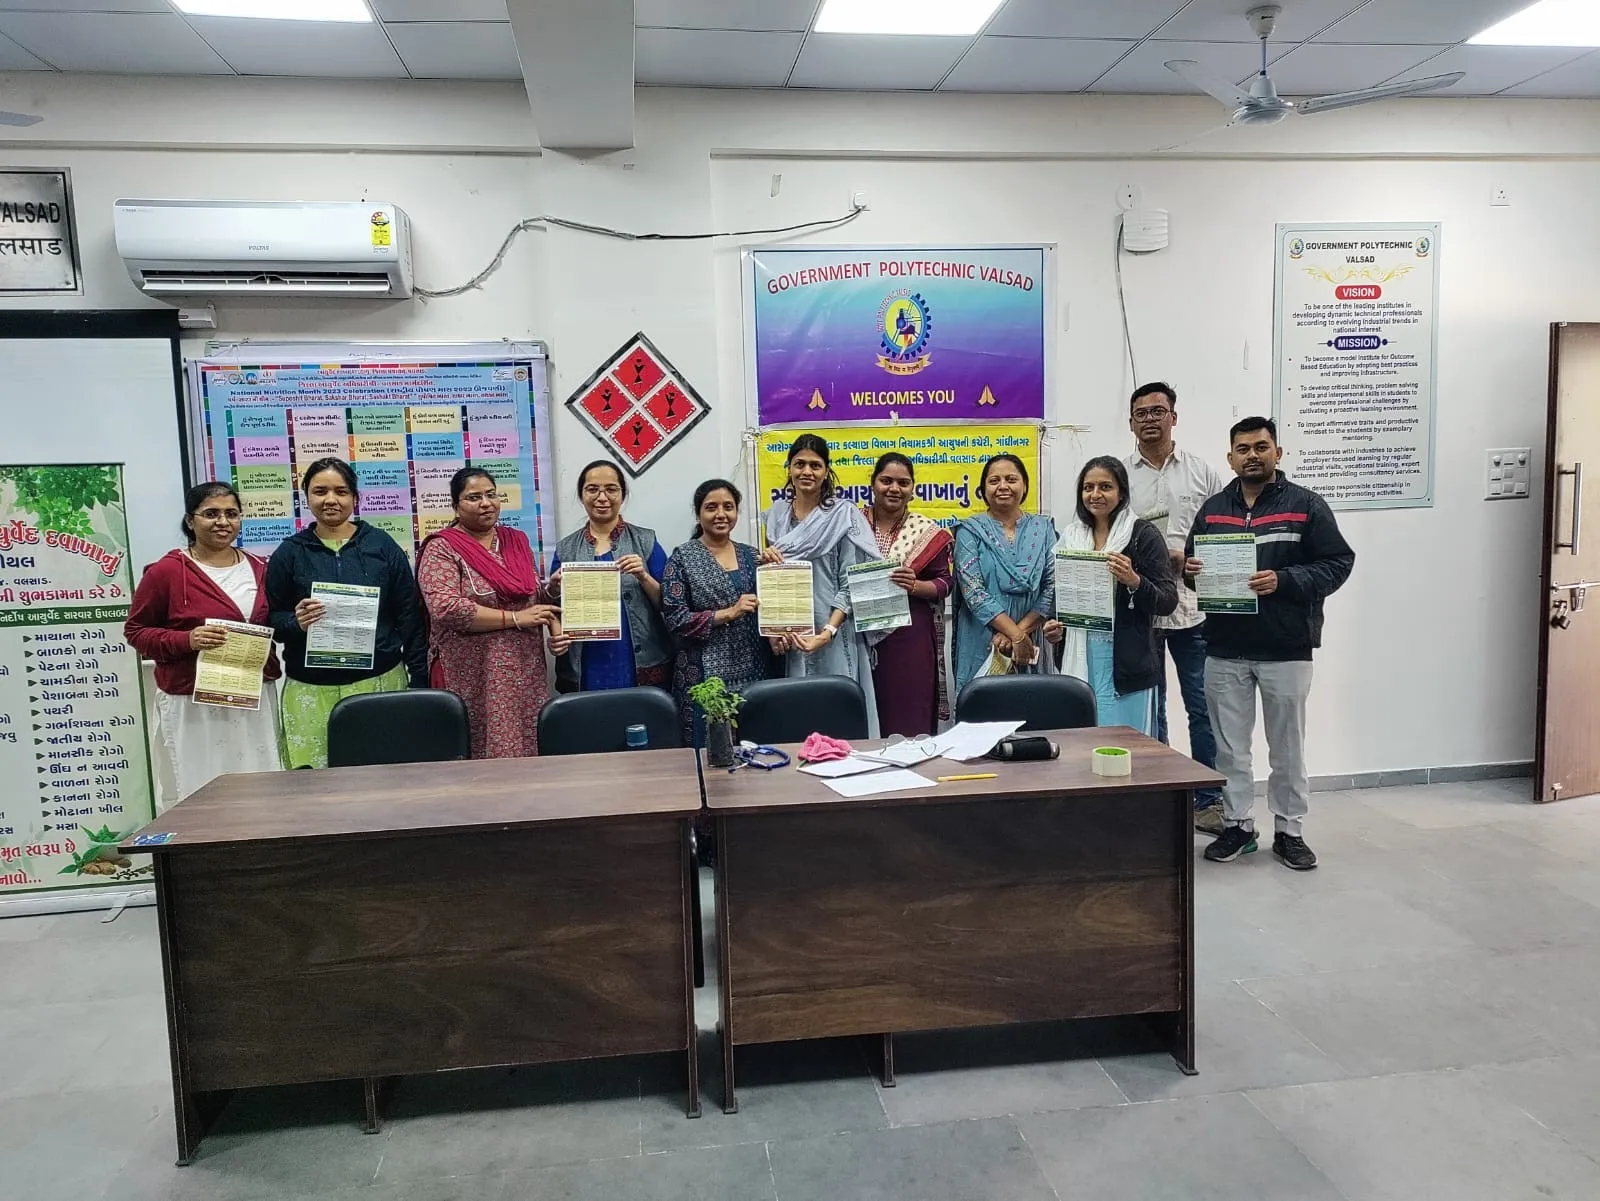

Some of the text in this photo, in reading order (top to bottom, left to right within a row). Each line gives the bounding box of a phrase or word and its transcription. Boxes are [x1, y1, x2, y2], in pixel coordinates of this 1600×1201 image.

[0, 238, 63, 255] लसाड
[1306, 241, 1413, 250] GOVERNMENT POLYTECHNIC
[768, 261, 1033, 295] GOVERNMENT POLYTECHNIC VALSAD
[1342, 288, 1375, 297] VISION
[1293, 311, 1325, 319] developing
[1328, 311, 1352, 319] dynamic
[1383, 309, 1422, 318] professionals
[1338, 339, 1377, 348] MISSION
[1356, 362, 1379, 370] adopting
[1309, 384, 1330, 392] develop
[851, 389, 955, 407] WELCOMES YOU
[1338, 398, 1370, 406] professional
[1388, 418, 1419, 426] productive
[844, 439, 868, 450] કલ્યાણ
[871, 437, 896, 448] વિભાગ
[996, 436, 1029, 447] ગાંધીનગર
[835, 458, 850, 466] તથા
[853, 455, 874, 465] જિલ્લા
[950, 455, 976, 463] વલસાડ
[1357, 455, 1381, 463] learning
[1383, 454, 1389, 462] by
[1359, 469, 1394, 477] consultancy
[911, 475, 971, 508] વાખાનું
[0, 520, 124, 577] યુર્વેદ દવાખાનું
[19, 589, 84, 606] શુભકામના
[89, 585, 105, 598] કરે
[28, 610, 60, 623] આયુર્વેદ
[64, 611, 92, 620] સારવાર
[35, 629, 105, 642] માથાના રોગો
[37, 643, 126, 656] બાળકો ના રોગો
[38, 659, 98, 671] પેટના રોગો
[40, 673, 118, 686] ચામડીના રોગો
[42, 688, 119, 701] પેશાબના રોગો
[43, 705, 73, 715] પથરી
[109, 716, 135, 727] રોગો
[47, 732, 111, 744] જાતીય રોગો
[48, 745, 124, 759] માનસીક રોગો
[77, 764, 87, 772] ન
[93, 760, 129, 771] આવવી
[52, 775, 119, 788] વાળના રોગો
[53, 790, 120, 802] કાનના રોગો
[98, 804, 123, 814] ખીલ
[56, 822, 78, 830] મસા
[0, 848, 21, 862] મૃત
[65, 838, 76, 853] છે
